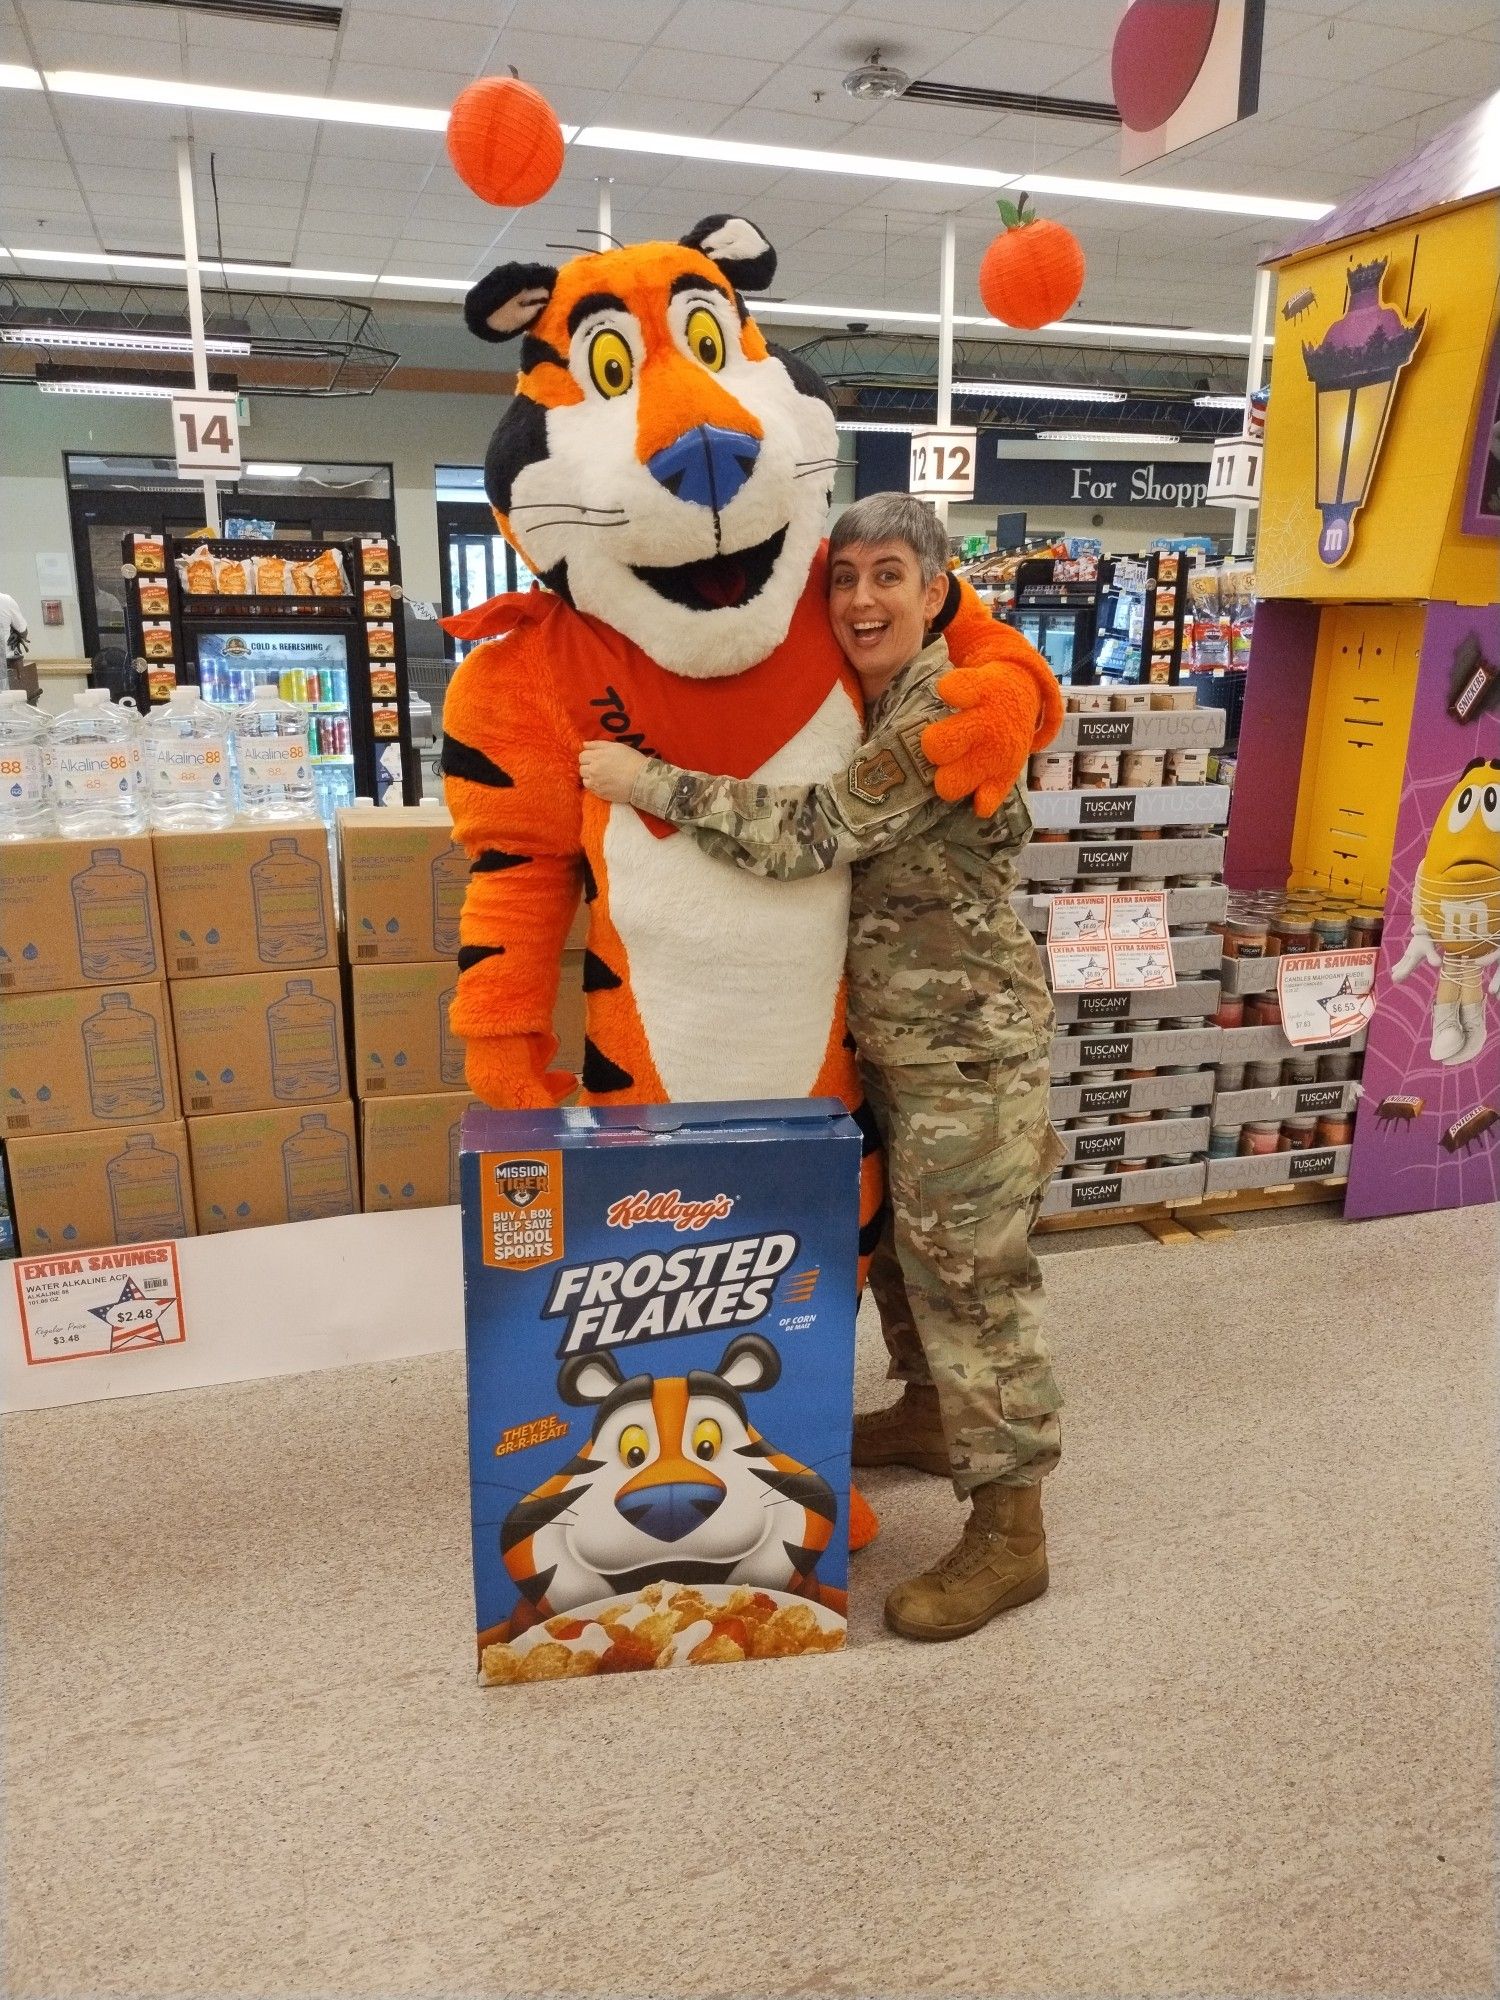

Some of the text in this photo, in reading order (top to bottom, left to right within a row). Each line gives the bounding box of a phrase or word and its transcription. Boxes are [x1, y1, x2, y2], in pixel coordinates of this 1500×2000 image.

[179, 413, 234, 454] 14
[912, 446, 927, 482] 12
[933, 446, 971, 481] 12
[1215, 455, 1236, 487] 11
[1071, 467, 1117, 500] For
[251, 641, 323, 651] COLD & REFRESHING
[1457, 669, 1486, 716] SNICKERS
[1083, 723, 1130, 735] TUSCANY
[60, 755, 127, 773] Alkaline88
[157, 750, 221, 765] Alkaline88
[1085, 800, 1132, 812] TUSCANY
[1083, 852, 1128, 863] TUSCANY
[18, 875, 49, 884] WATER
[1054, 897, 1104, 906] EXTRA SAVINGS
[1134, 895, 1162, 903] SAVINGS
[1285, 954, 1374, 972] EXTRA SAVINGS
[1312, 973, 1345, 981] MAHOGANY
[1082, 997, 1128, 1008] TUSCANY
[1332, 1002, 1356, 1013] $6.53
[1083, 1044, 1129, 1056] TUSCANY
[1084, 1089, 1128, 1101] TUSCANY
[1300, 1090, 1341, 1103] TUSCANY
[1079, 1137, 1122, 1149] TUSCANY
[57, 1161, 87, 1171] WATER
[1294, 1156, 1333, 1170] TUSCANY
[496, 1165, 548, 1179] MISSION
[496, 1177, 549, 1192] TIGER
[1075, 1183, 1119, 1197] TUSCANY
[493, 1209, 553, 1223] BUY A BOX
[607, 1189, 733, 1231] Kellogg's
[493, 1219, 553, 1233] HELP SAVE
[493, 1229, 553, 1245] SCHOOL
[494, 1243, 553, 1260] SPORTS
[24, 1249, 168, 1281] EXTRA SAVINGS
[549, 1234, 796, 1313] FROSTED
[26, 1273, 128, 1293] WATER ALKALINE ACP
[27, 1290, 61, 1300] ALKALINE
[117, 1308, 153, 1323] $2.48
[565, 1278, 774, 1352] FLAKES
[778, 1314, 817, 1326] OF CORN
[35, 1321, 87, 1337] Regular Price
[53, 1334, 80, 1345] $3.48
[503, 1416, 558, 1442] THEY'RE
[495, 1423, 569, 1456] GR-R-REAT!
